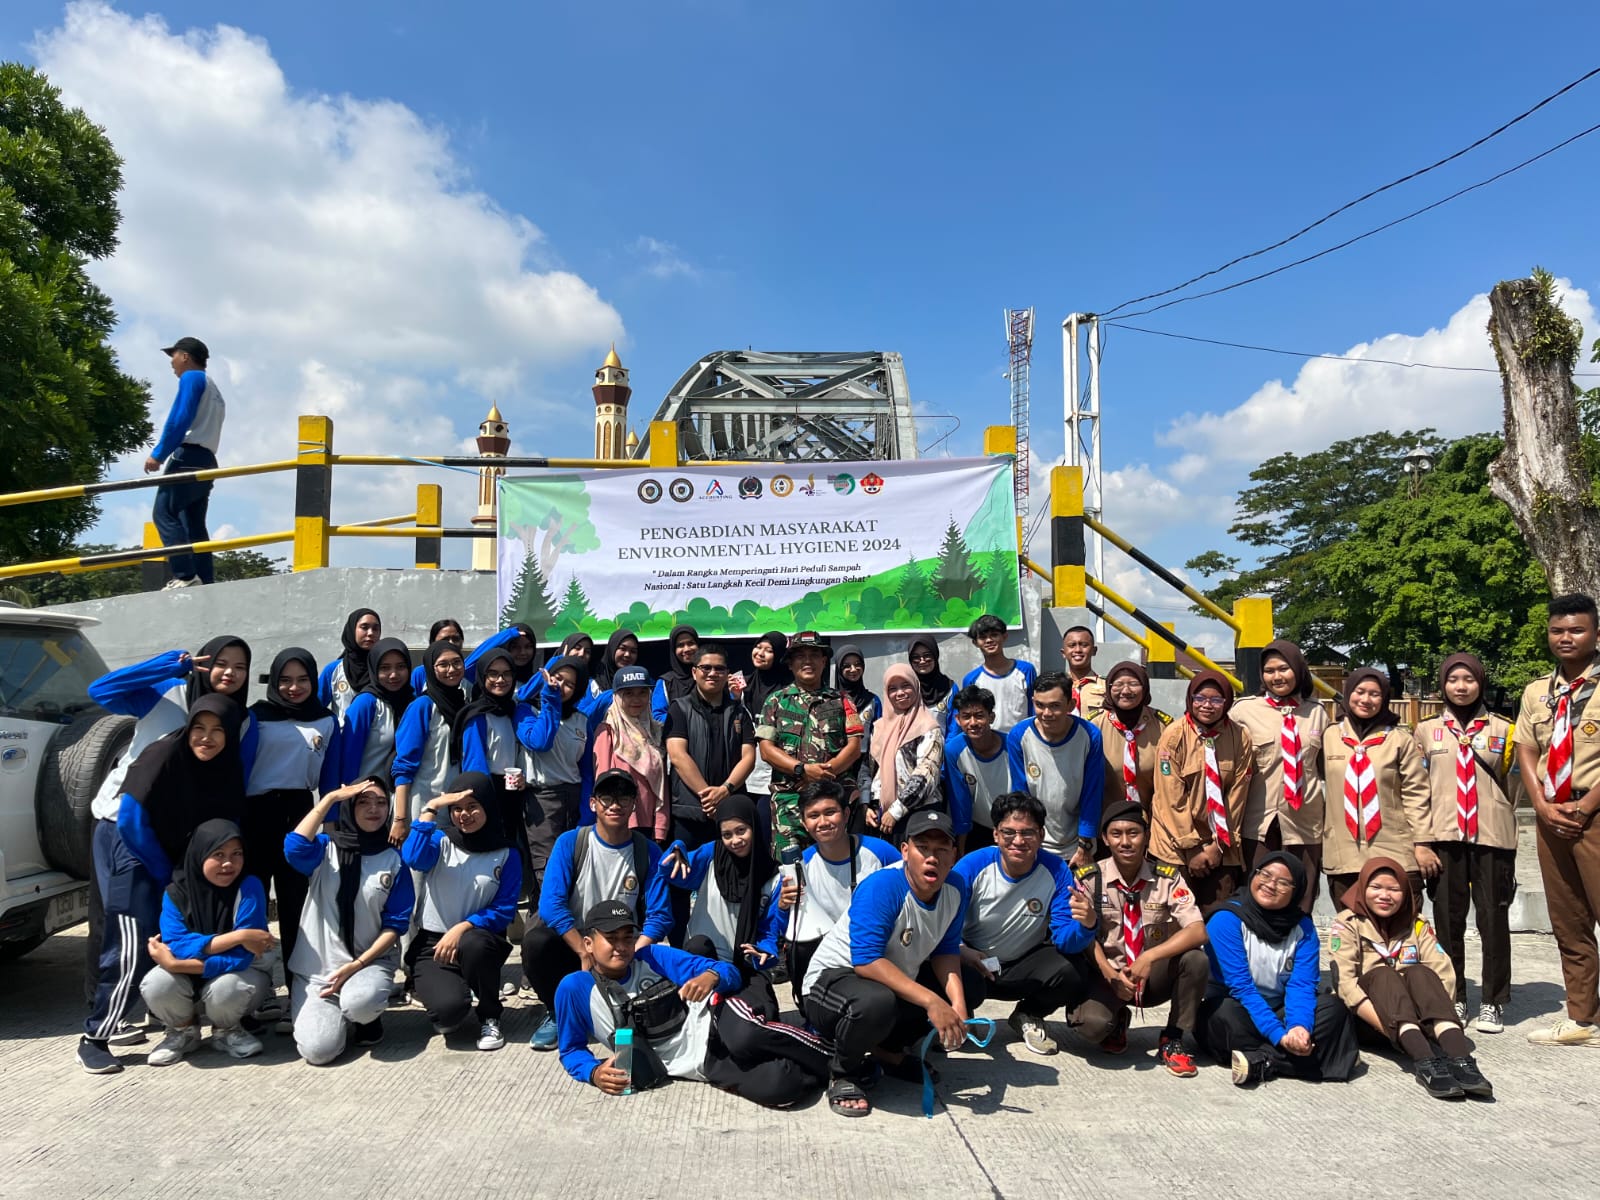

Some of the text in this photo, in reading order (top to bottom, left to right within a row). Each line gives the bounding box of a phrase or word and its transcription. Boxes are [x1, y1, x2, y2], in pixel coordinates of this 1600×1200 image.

[640, 520, 879, 540] PENGABDIAN MASYARAKAT
[618, 538, 901, 559] ENVIRONMENTAL HYGIENE 2024
[657, 569, 685, 578] Dalam
[687, 568, 718, 579] Rangka
[720, 566, 778, 577] Memperingati
[780, 565, 799, 574] Hari
[800, 564, 826, 573] Peduli
[828, 563, 861, 573] Sampah
[644, 581, 681, 591] Nasional
[687, 581, 706, 589] Satu
[707, 579, 743, 591] Langkah
[745, 578, 766, 588] Kecil
[767, 577, 790, 587] Demi
[791, 575, 841, 587] Lingkungan
